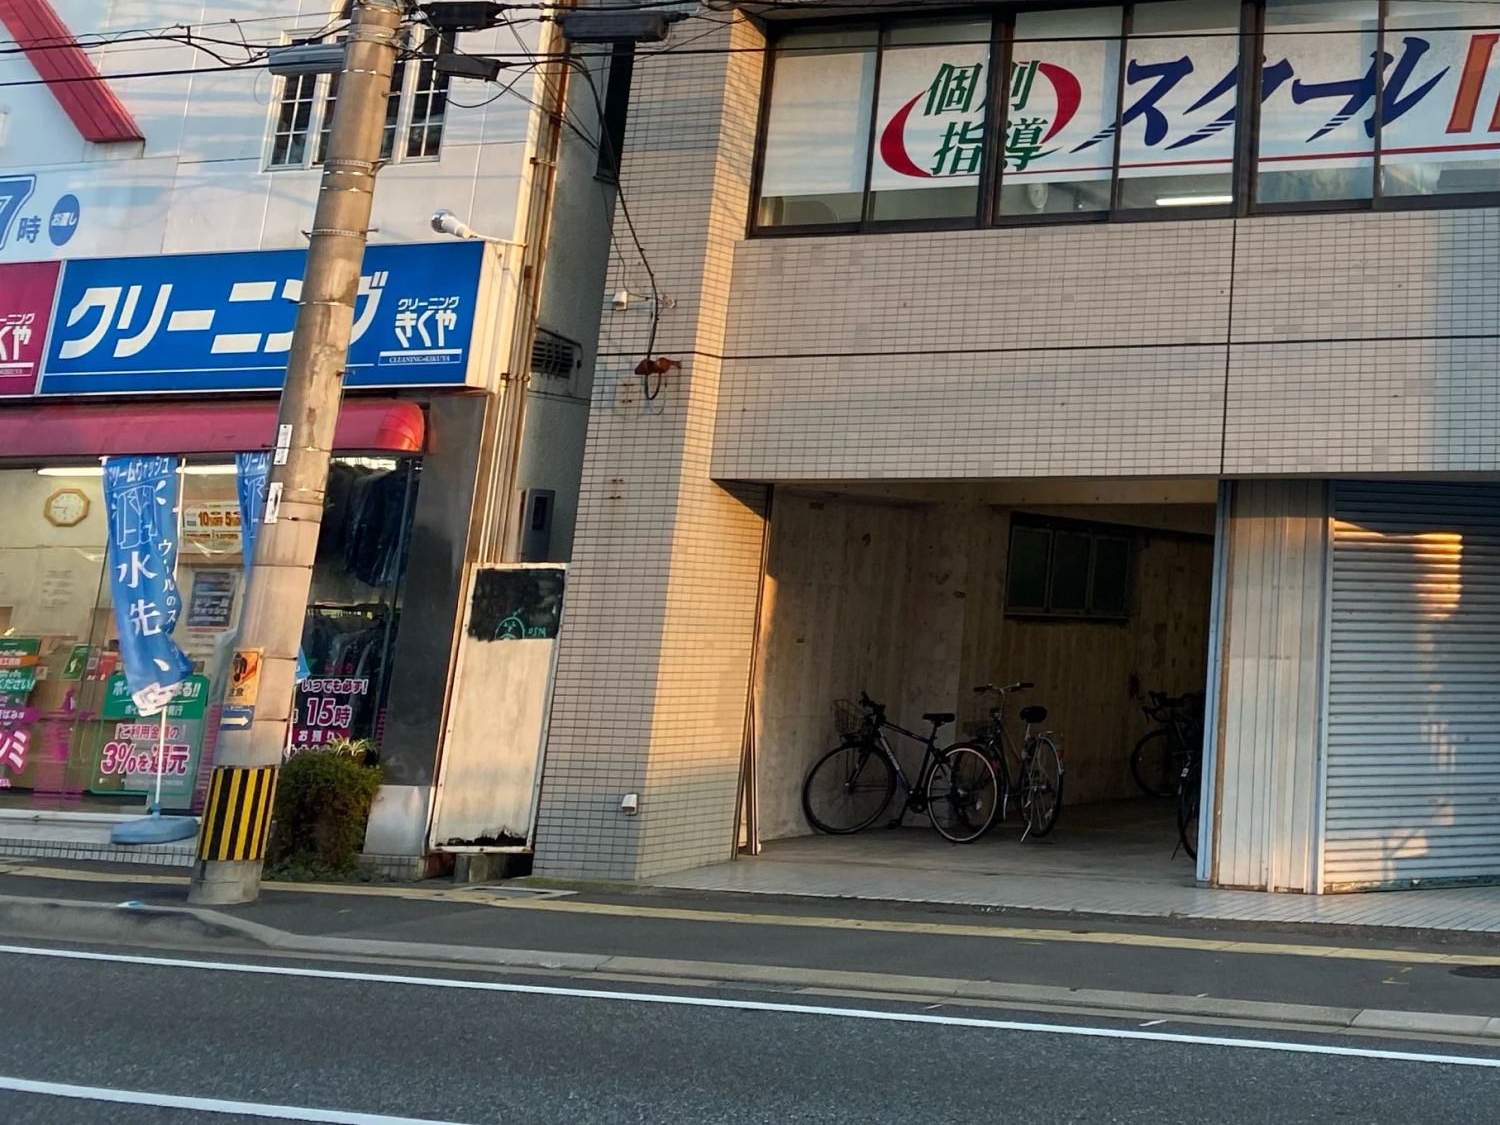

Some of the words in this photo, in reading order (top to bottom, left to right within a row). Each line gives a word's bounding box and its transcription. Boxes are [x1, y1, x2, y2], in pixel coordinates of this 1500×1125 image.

[930, 117, 1063, 175] 指導
[397, 296, 460, 311] クリーニング
[395, 309, 457, 348] きくや
[301, 678, 369, 696] いつでも必ず!
[307, 697, 353, 728] 15時
